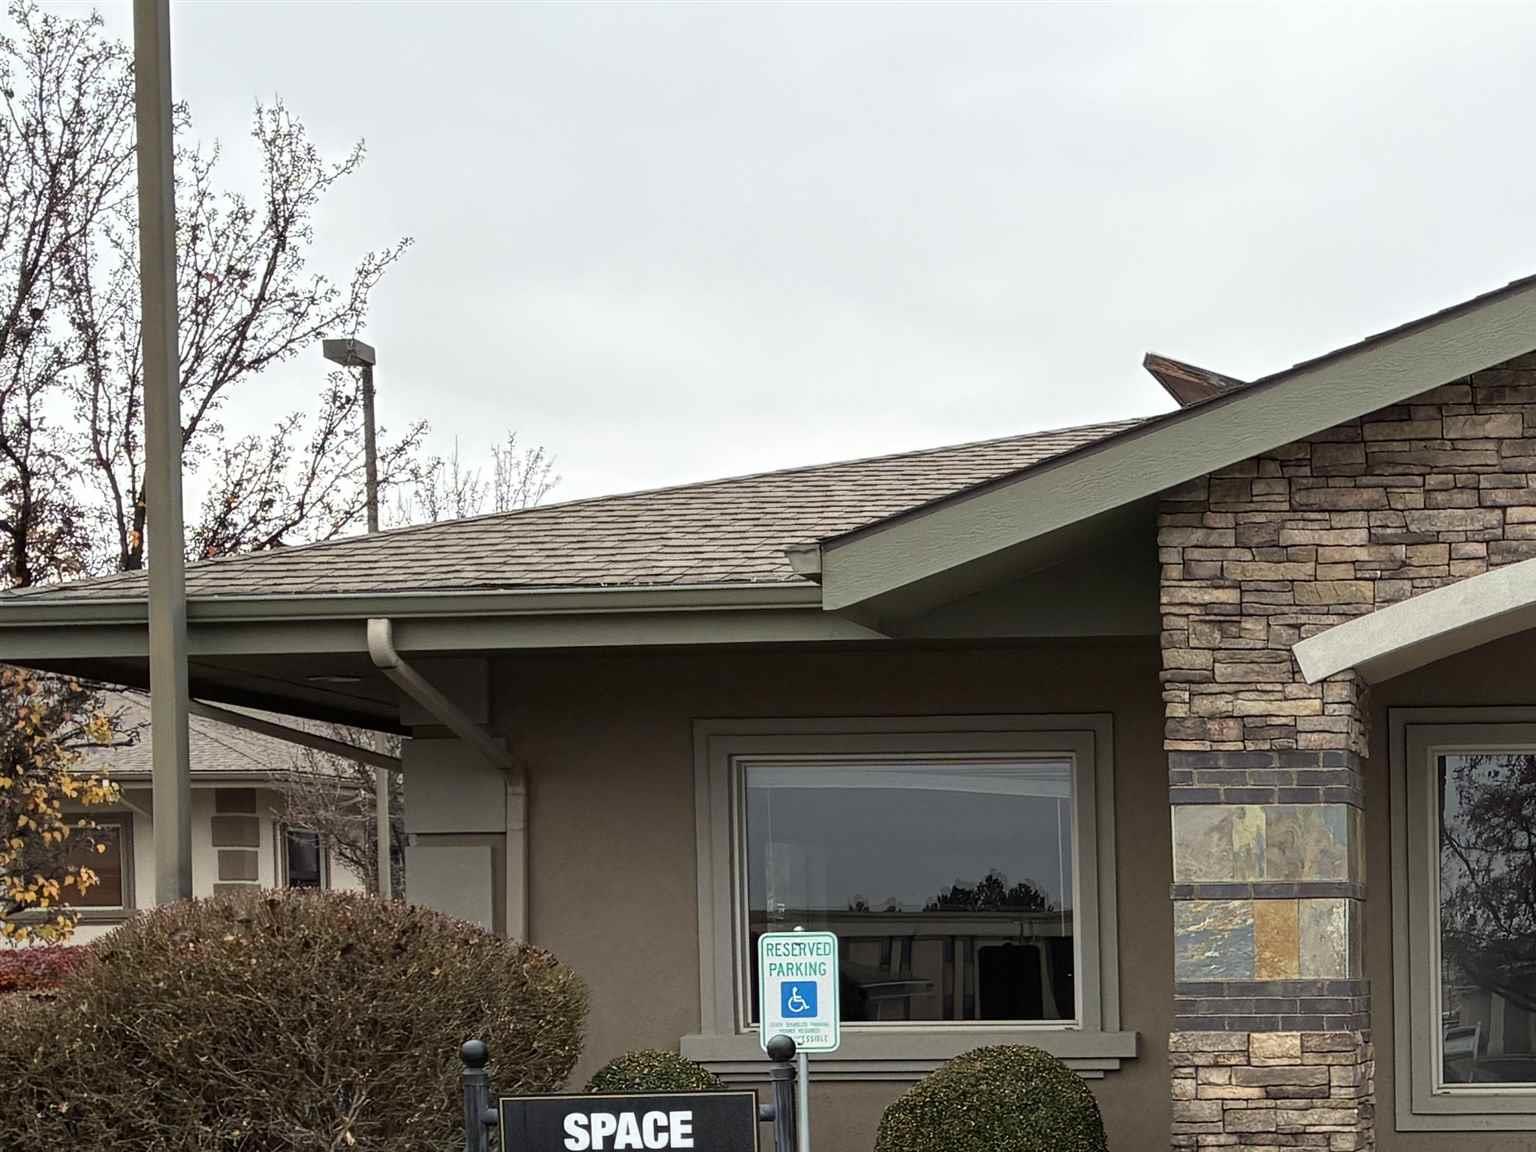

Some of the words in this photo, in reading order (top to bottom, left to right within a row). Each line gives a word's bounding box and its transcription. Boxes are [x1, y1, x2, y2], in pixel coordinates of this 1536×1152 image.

[766, 942, 831, 957] RESERVED
[768, 962, 827, 976] PARKING
[563, 1110, 694, 1151] SPACE
